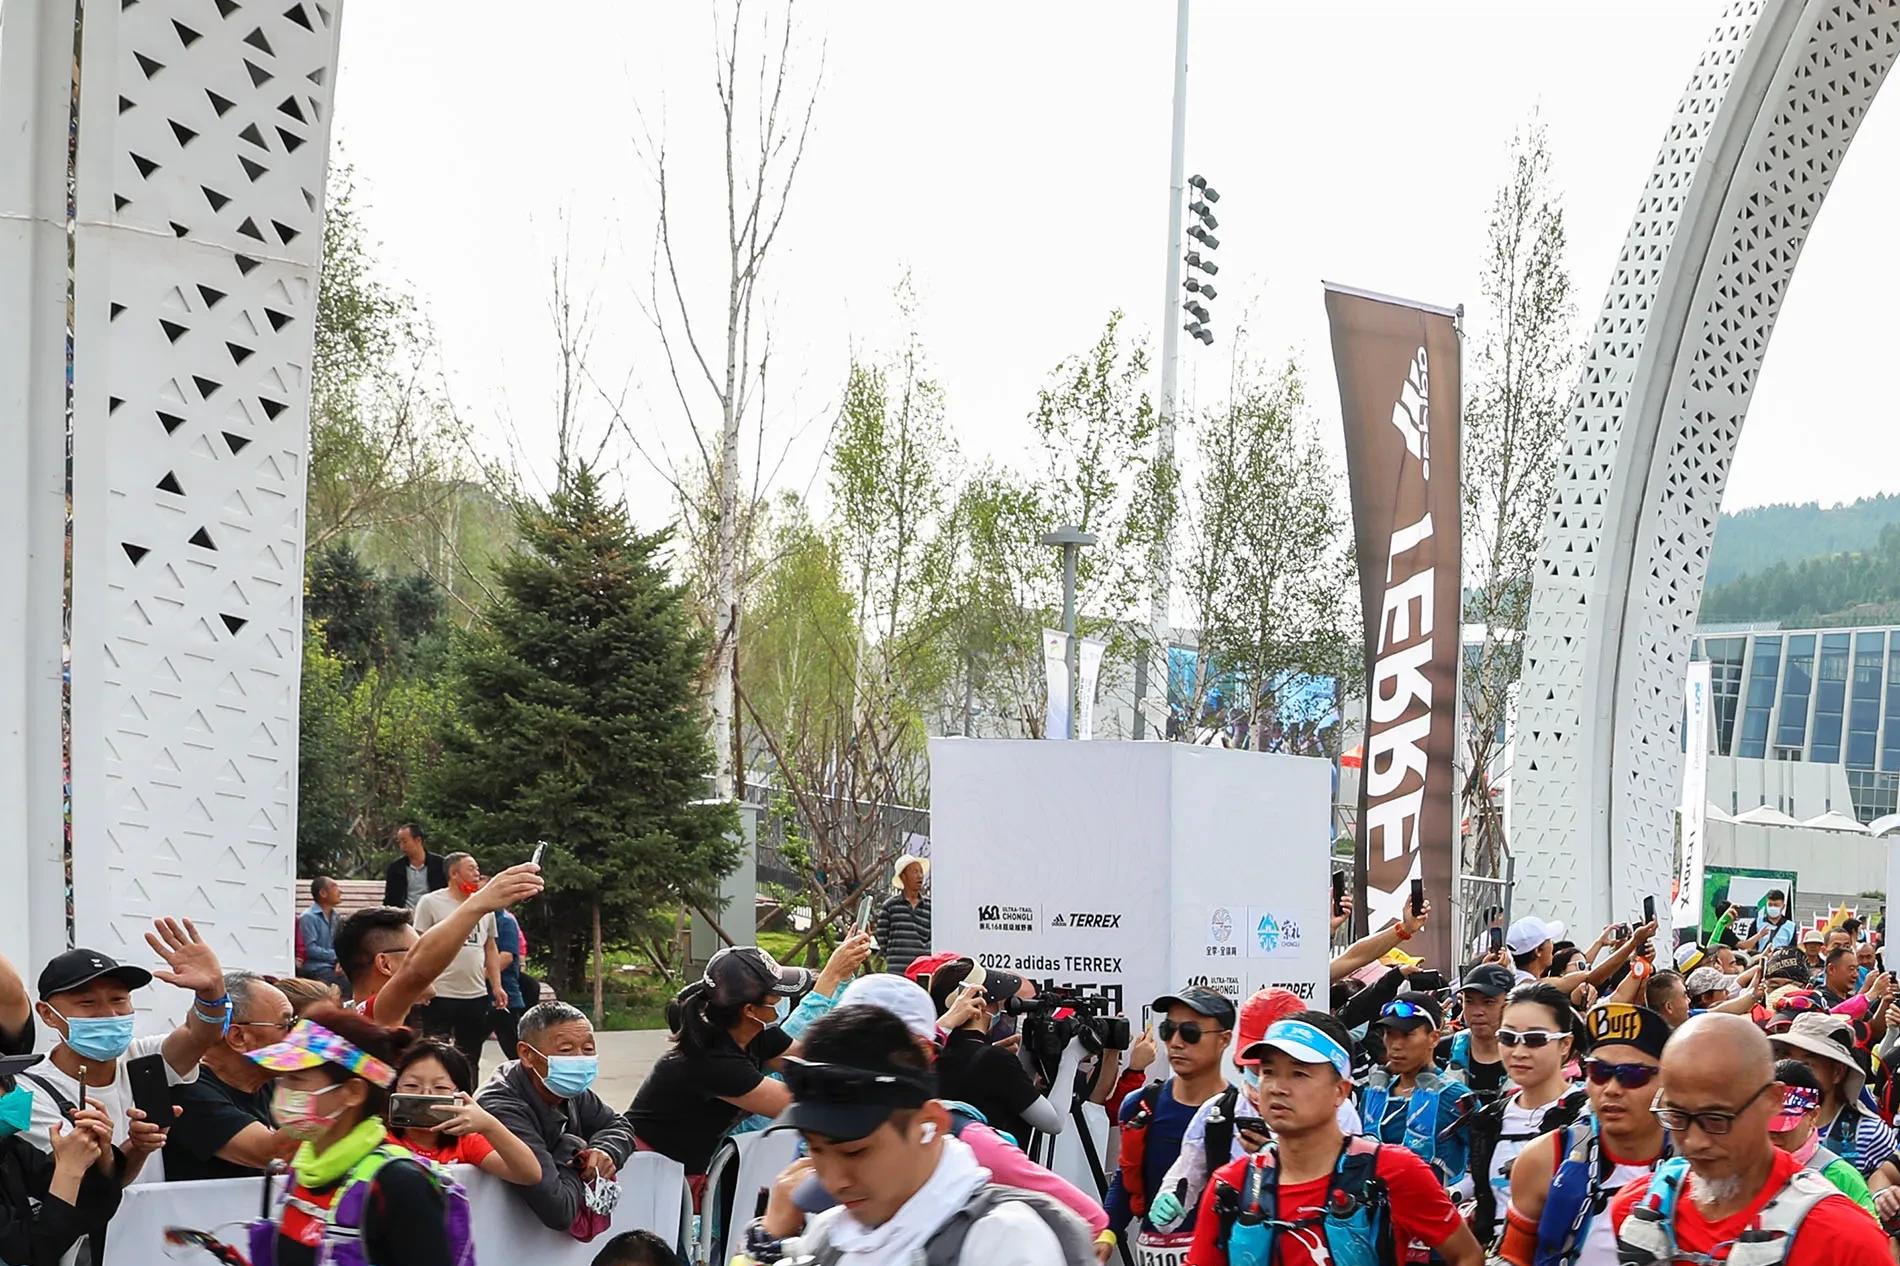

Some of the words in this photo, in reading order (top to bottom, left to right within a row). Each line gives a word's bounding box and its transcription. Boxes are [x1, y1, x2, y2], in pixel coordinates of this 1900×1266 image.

[1002, 913, 1033, 921] CHONGLI
[1070, 914, 1121, 928] TERREX
[980, 954, 1011, 970] 2022
[1015, 955, 1060, 971] adidas
[1064, 957, 1122, 973] TERREX
